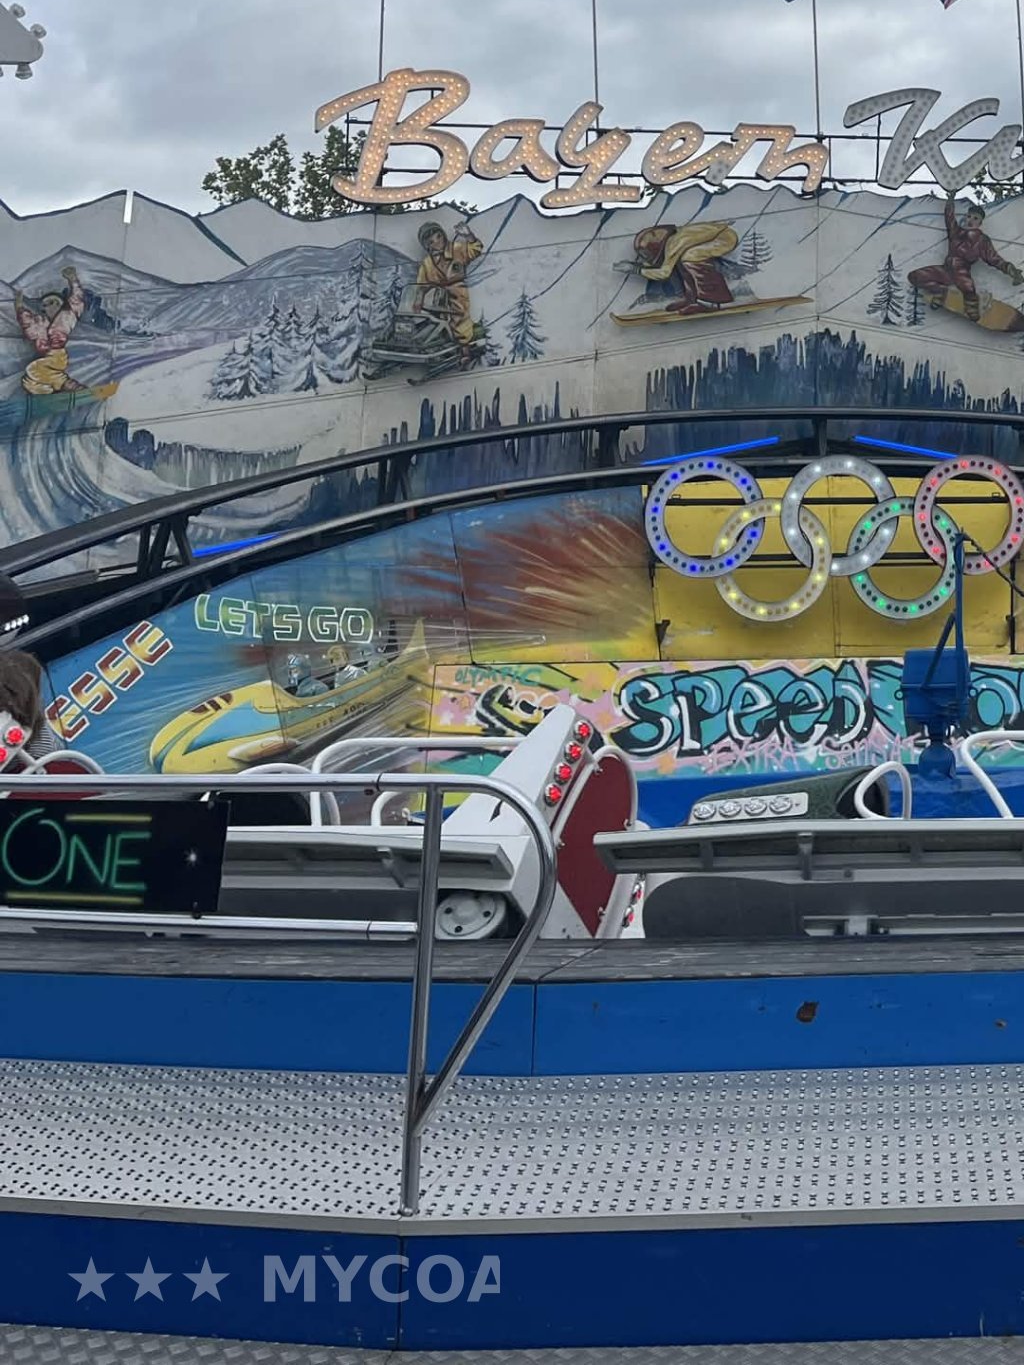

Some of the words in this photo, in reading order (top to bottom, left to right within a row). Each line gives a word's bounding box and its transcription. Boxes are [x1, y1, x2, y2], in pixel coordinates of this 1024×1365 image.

[315, 68, 829, 209] Bayern
[307, 606, 374, 643] GO
[614, 662, 870, 757] SPEED
[2, 808, 152, 890] ONE
